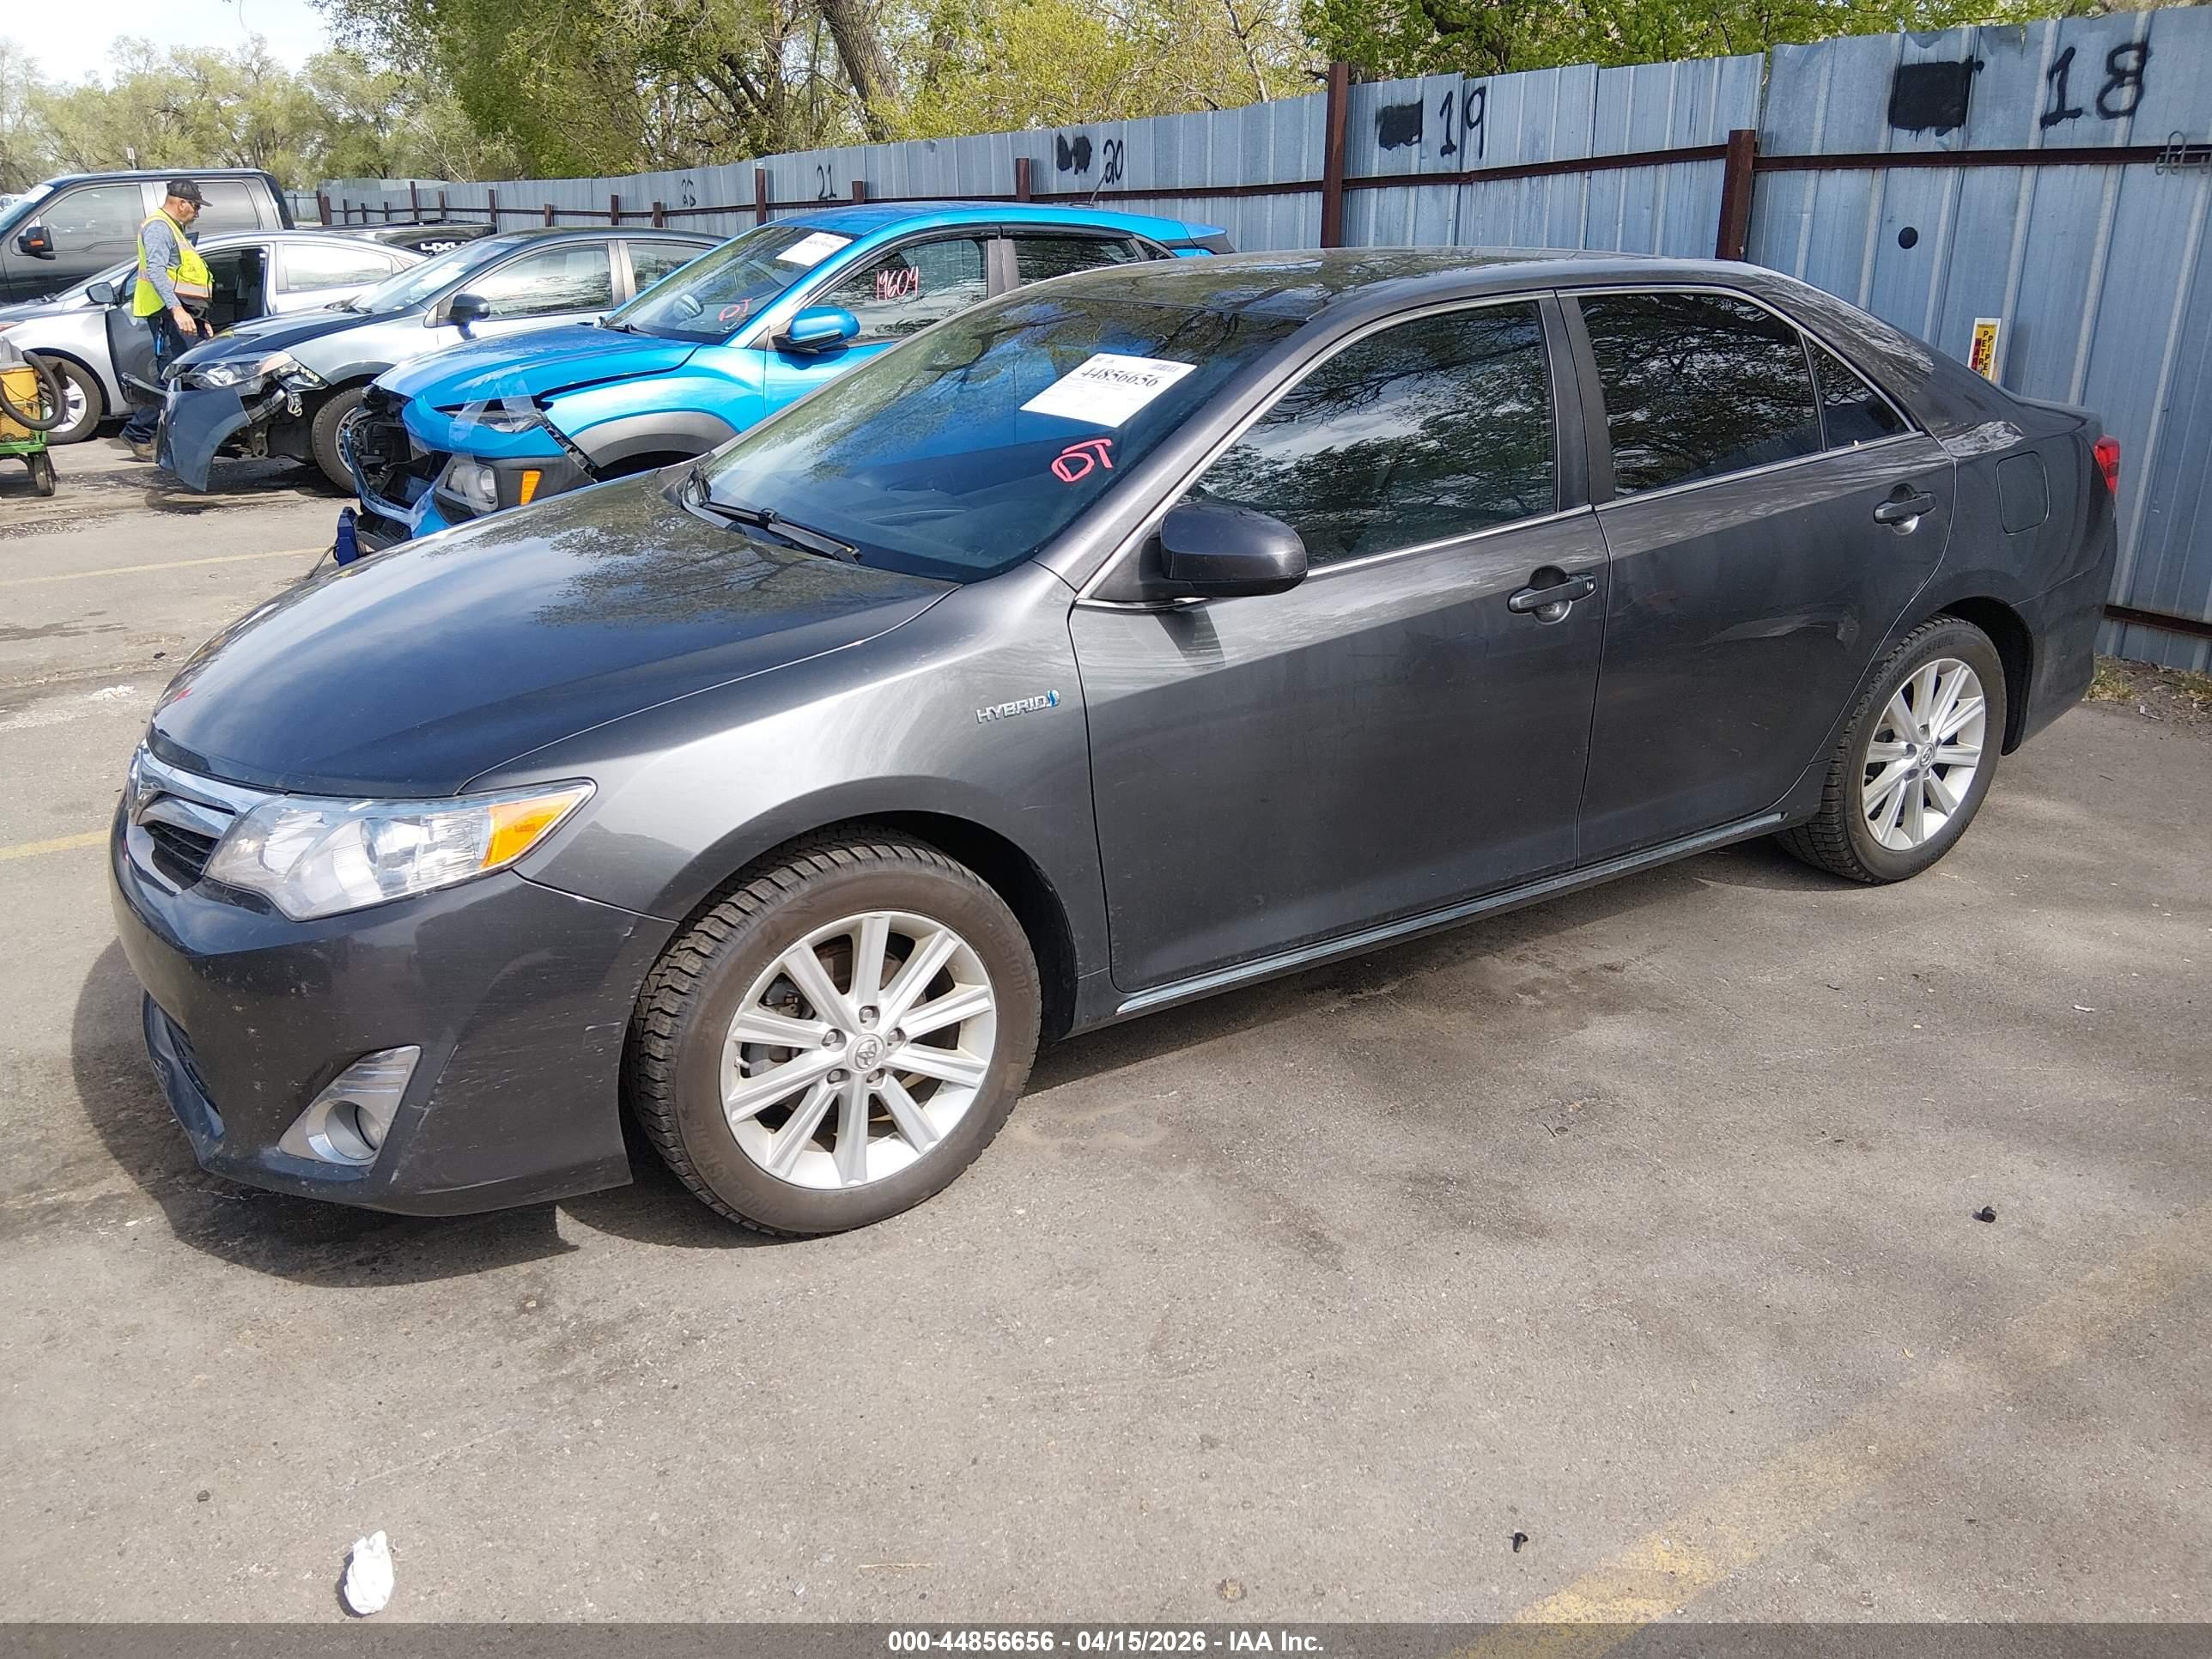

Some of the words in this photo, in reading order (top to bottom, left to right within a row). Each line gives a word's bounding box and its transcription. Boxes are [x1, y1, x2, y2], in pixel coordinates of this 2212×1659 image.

[2040, 42, 2152, 130] 18
[1439, 86, 1486, 160] 19
[817, 164, 837, 201] 21
[1103, 138, 1124, 185] 20
[1080, 367, 1163, 387] 44856656
[976, 695, 1048, 724] HYBRID
